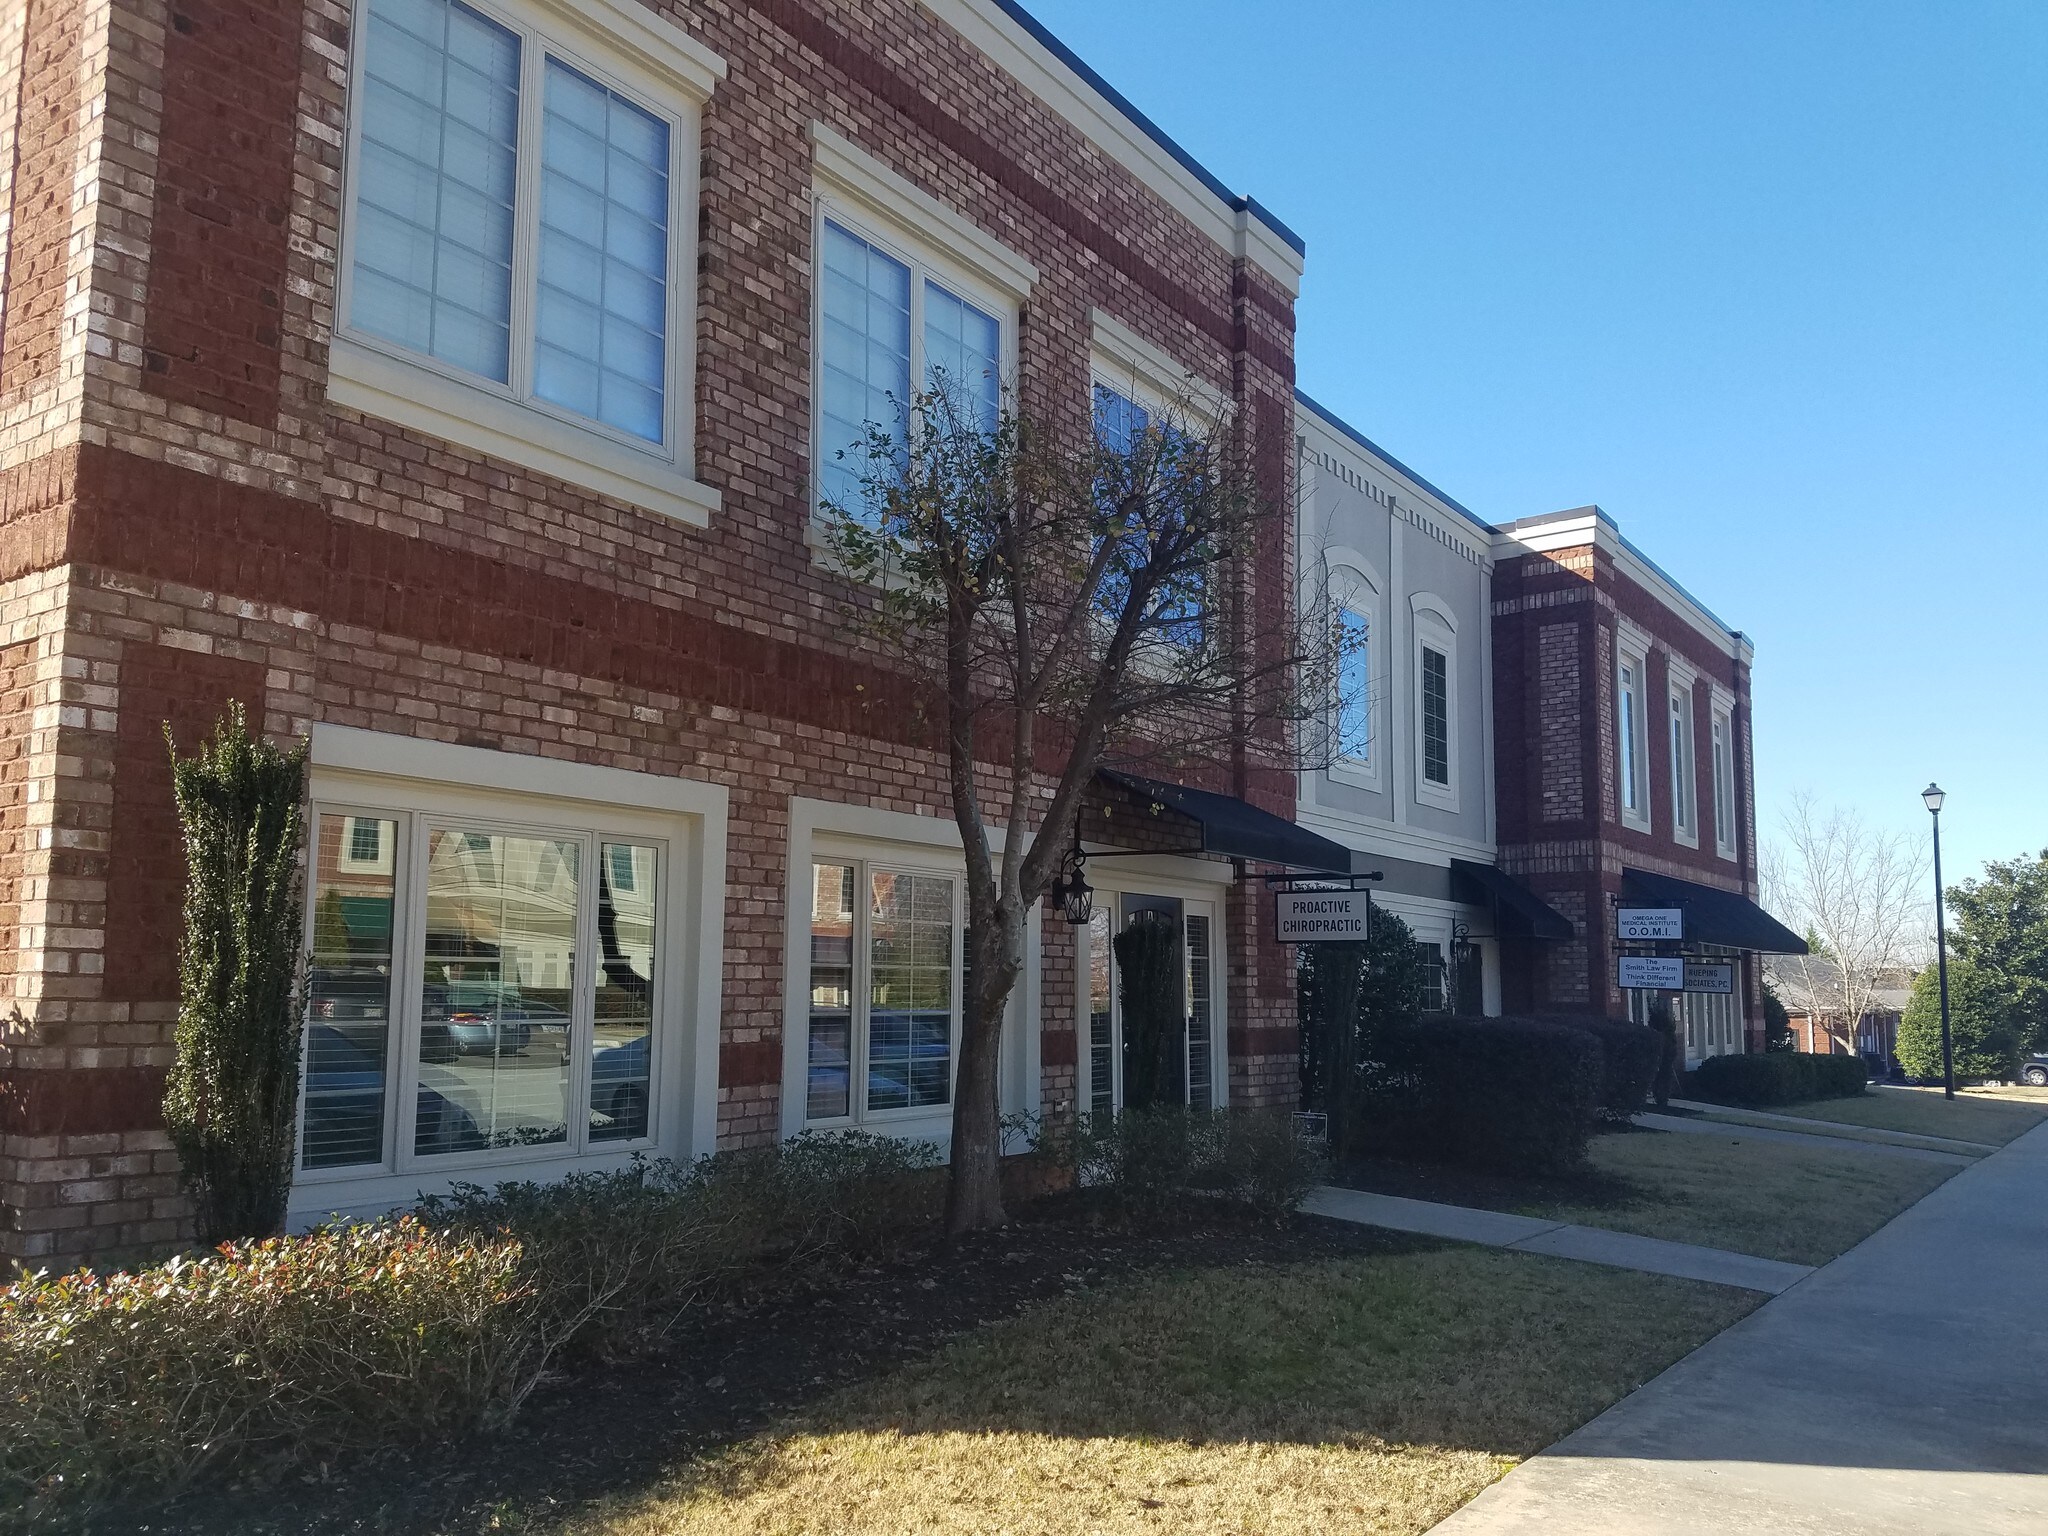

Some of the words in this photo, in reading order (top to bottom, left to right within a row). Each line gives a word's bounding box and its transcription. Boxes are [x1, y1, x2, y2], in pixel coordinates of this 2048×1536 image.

[1292, 900, 1351, 914] PROACTIVE
[1283, 919, 1361, 933] CHIROPRACTIC
[1628, 927, 1671, 936] O.O.M.I.
[1688, 968, 1718, 977] RUEPING
